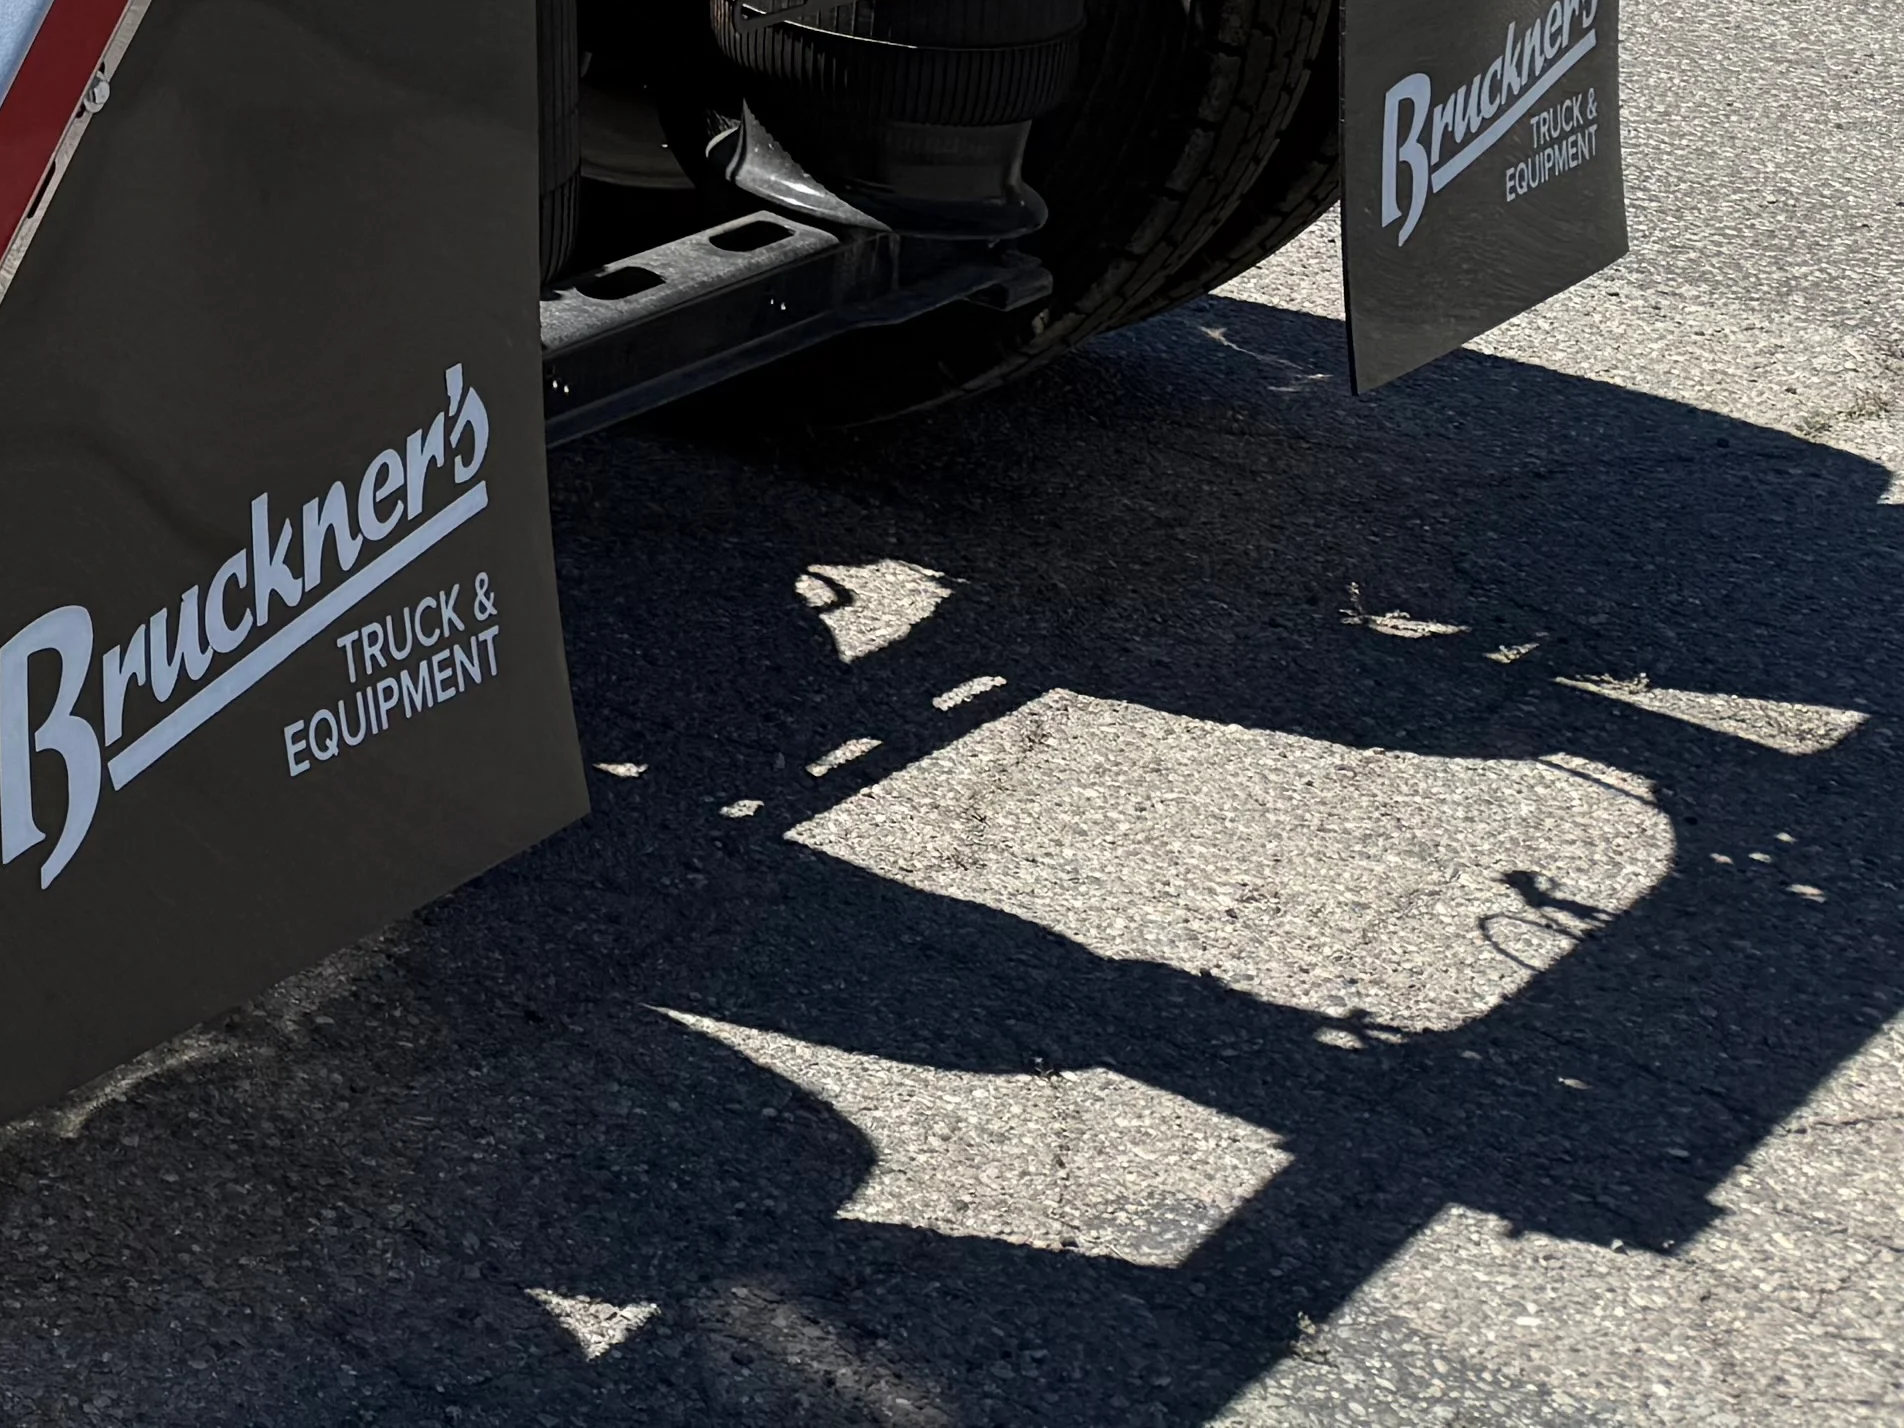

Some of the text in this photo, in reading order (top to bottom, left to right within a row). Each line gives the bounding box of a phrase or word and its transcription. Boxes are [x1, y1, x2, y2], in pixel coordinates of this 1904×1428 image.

[1506, 124, 1598, 202] EQUIPMENT
[1530, 87, 1597, 148] TRUCK &
[337, 572, 498, 683] TRUCK &
[284, 626, 500, 777] EQUIPMENT
